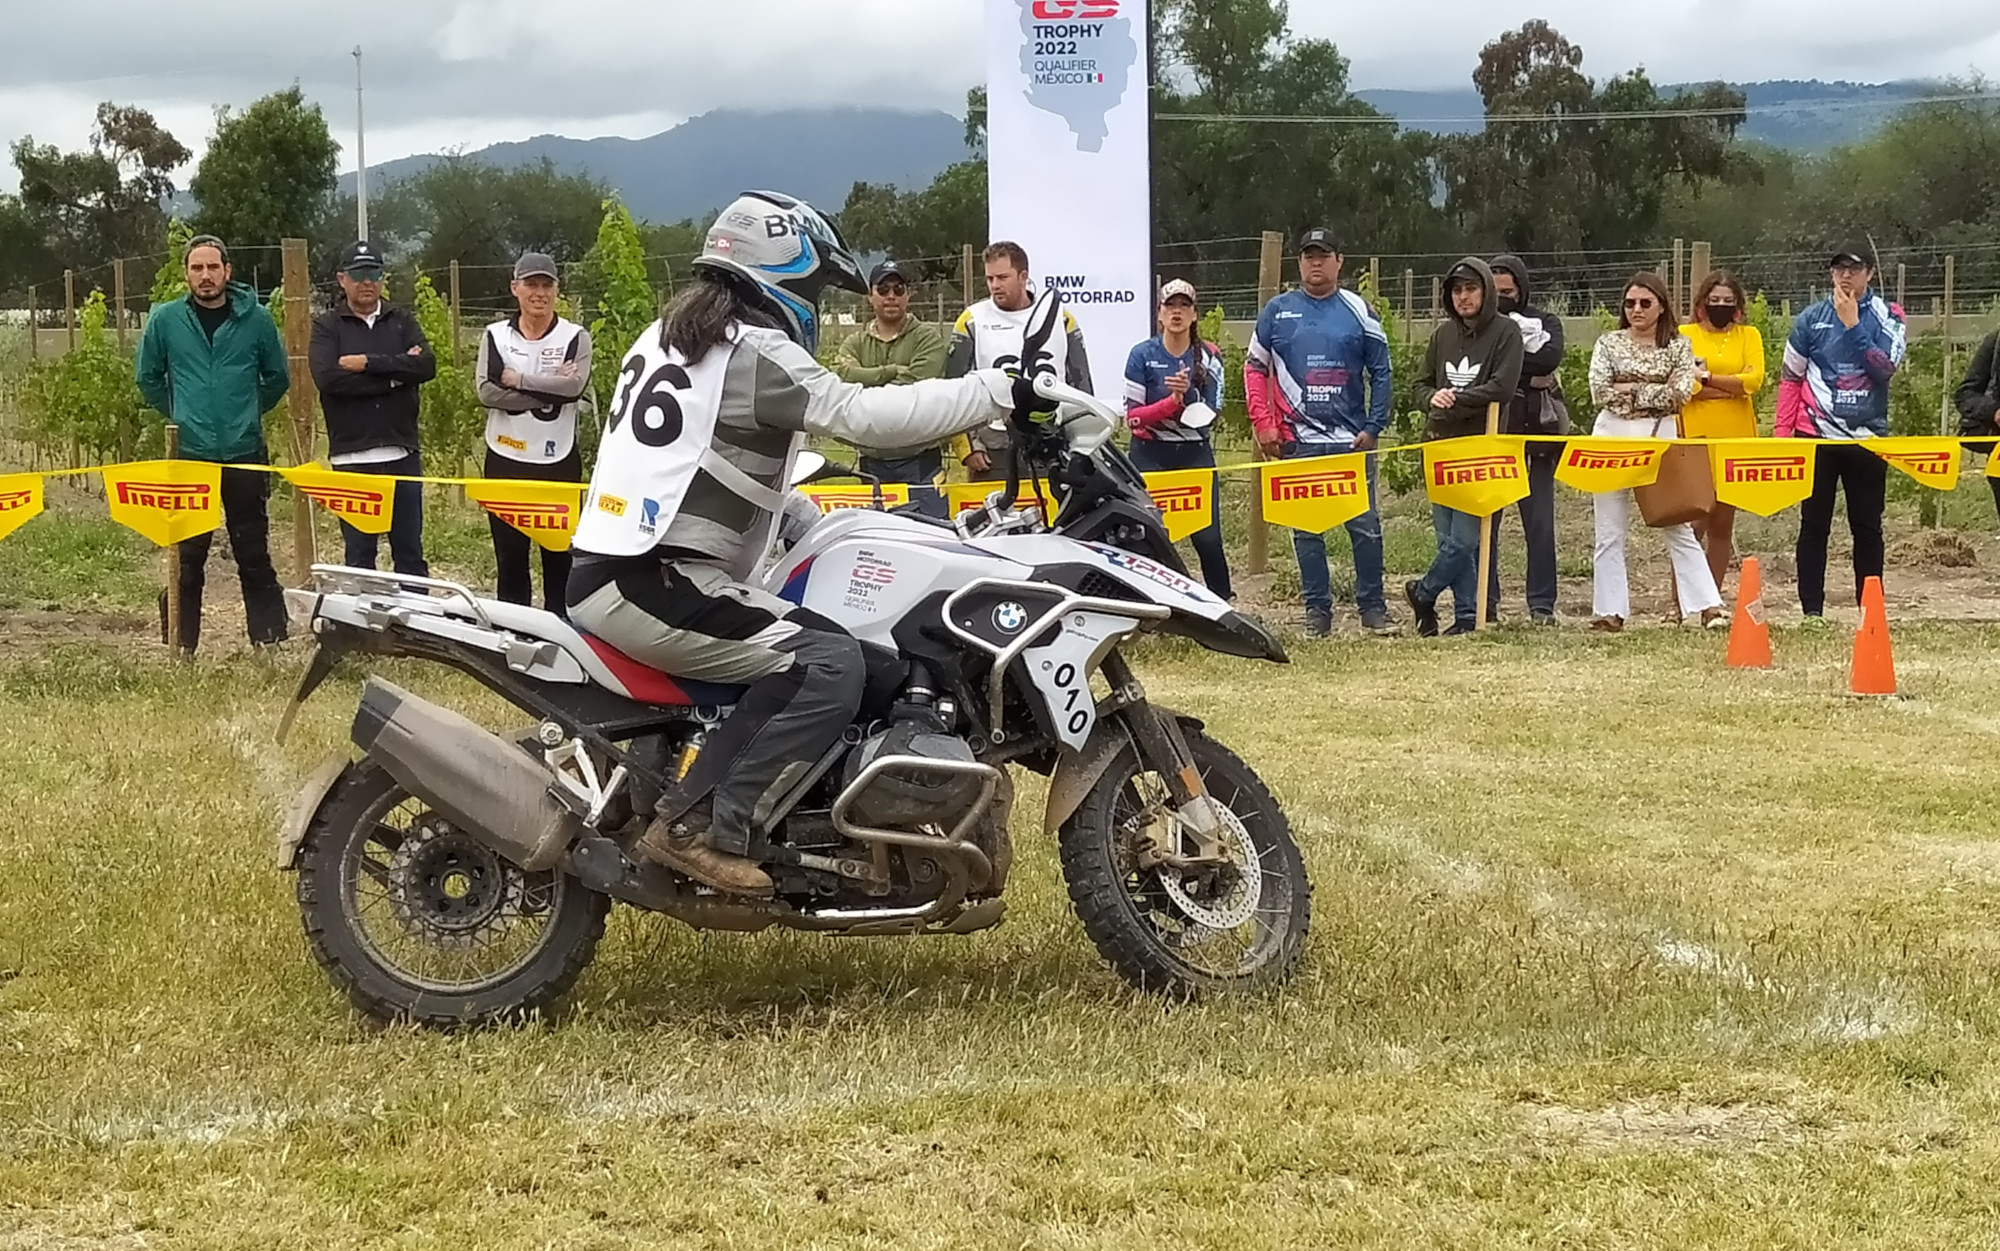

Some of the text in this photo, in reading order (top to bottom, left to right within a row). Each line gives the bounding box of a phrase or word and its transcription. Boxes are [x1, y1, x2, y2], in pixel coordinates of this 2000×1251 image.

[1033, 24, 1104, 39] TROPHY
[1034, 41, 1078, 55] 2022
[1034, 59, 1097, 71] QUALIFIER
[1044, 275, 1085, 288] BMW
[1058, 291, 1135, 304] OTORRAD
[1306, 385, 1342, 395] TROPHY
[1306, 394, 1330, 402] 2022
[610, 354, 692, 447] 36
[1568, 449, 1655, 469] PIRELLI
[1434, 455, 1519, 486] PIRELLI
[1725, 456, 1806, 483] PIRELLI
[116, 481, 210, 510] PIRELLI
[1270, 470, 1357, 501] PIRELLI
[1149, 485, 1203, 513] ELLI
[477, 500, 570, 530] RELLI
[852, 564, 898, 584] GS
[847, 586, 868, 597] 2022
[850, 579, 884, 592] TROPHY
[1053, 663, 1089, 734] 010
